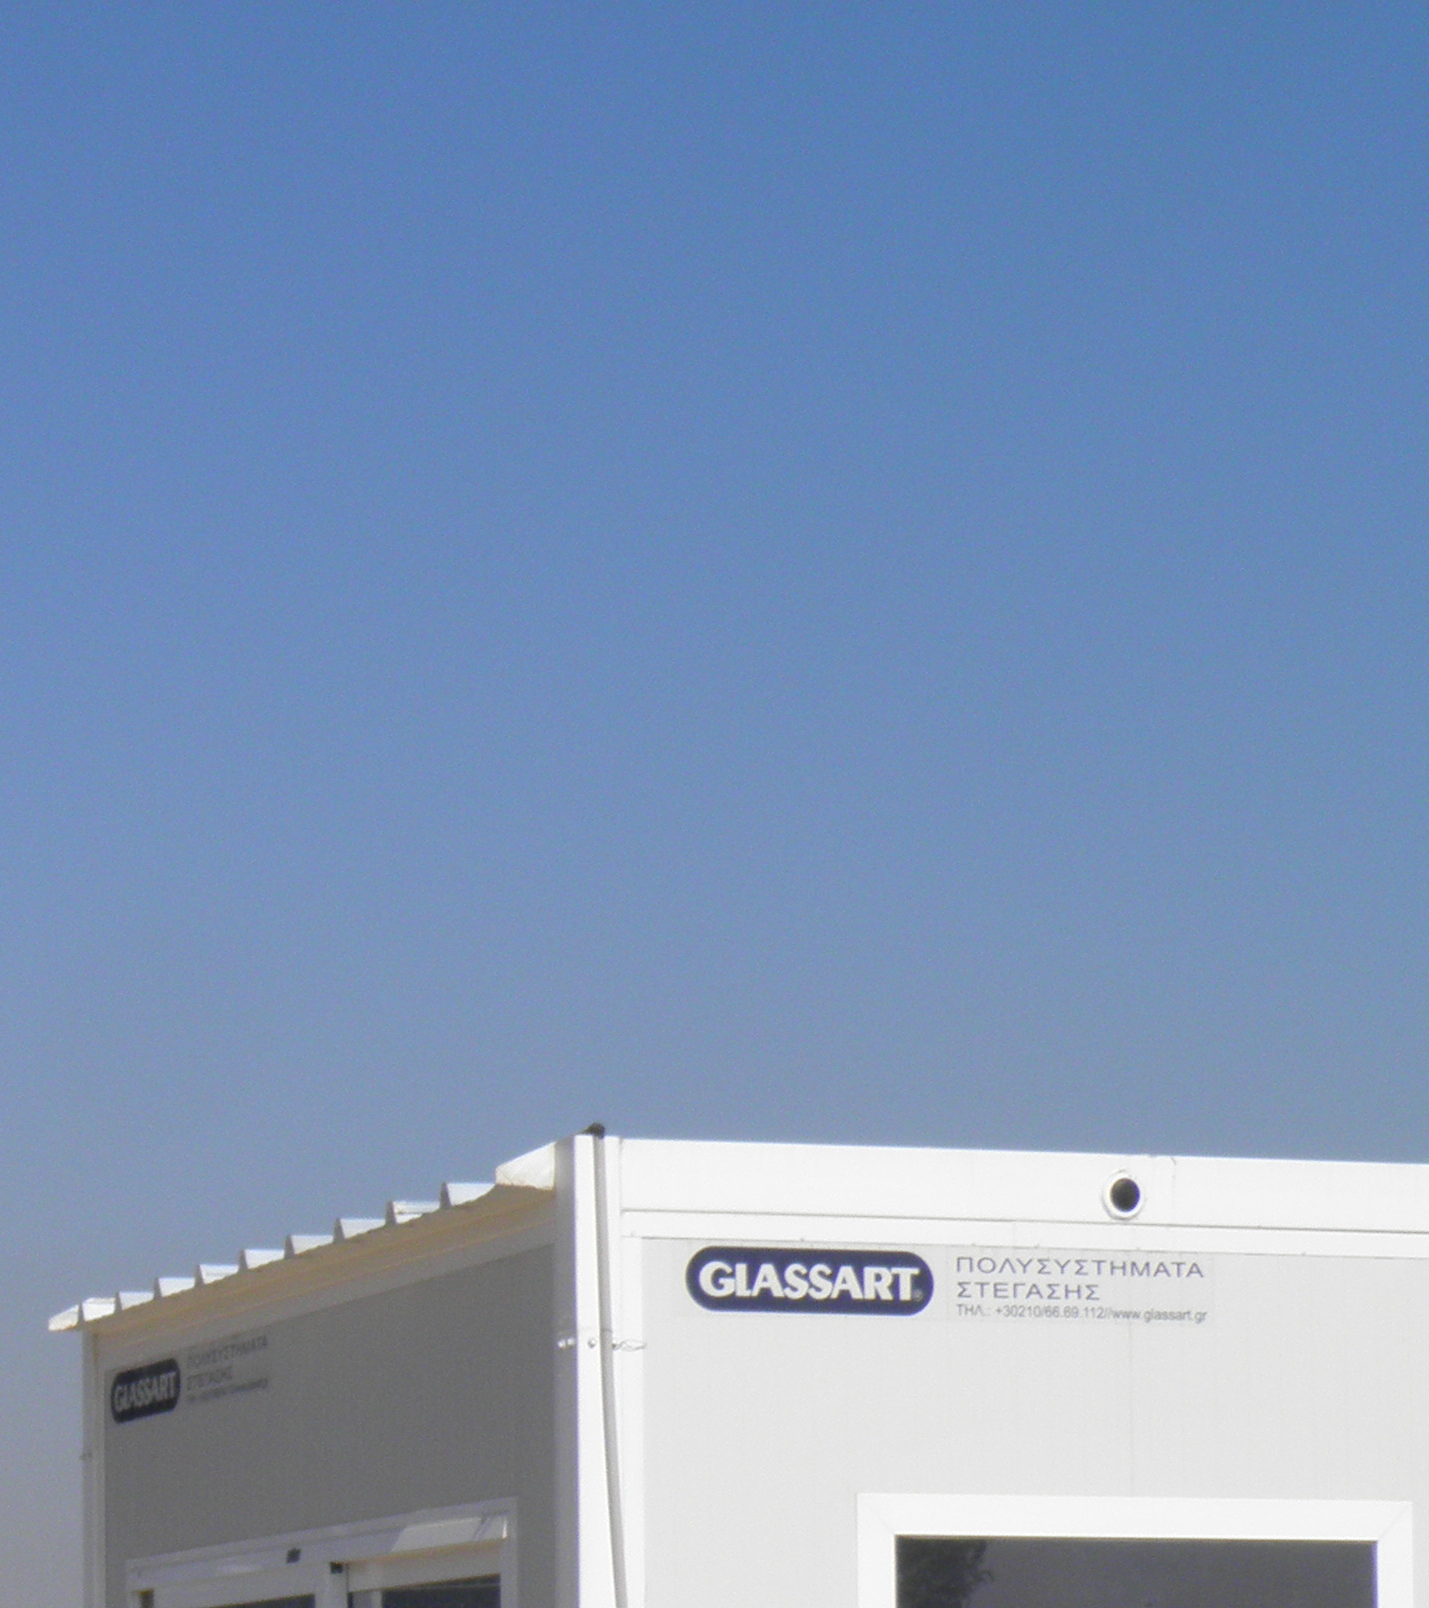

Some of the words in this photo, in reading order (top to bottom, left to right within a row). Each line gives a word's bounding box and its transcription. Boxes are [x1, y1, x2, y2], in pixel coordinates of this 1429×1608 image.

[698, 1260, 921, 1302] GLASSART
[956, 1256, 1205, 1279] ΠΟΛΥΣΥΣΤΗΜΑΤΑ
[956, 1281, 1101, 1301] ΣΤΕΓΑΣΗΣ
[113, 1371, 177, 1412] GLASSART
